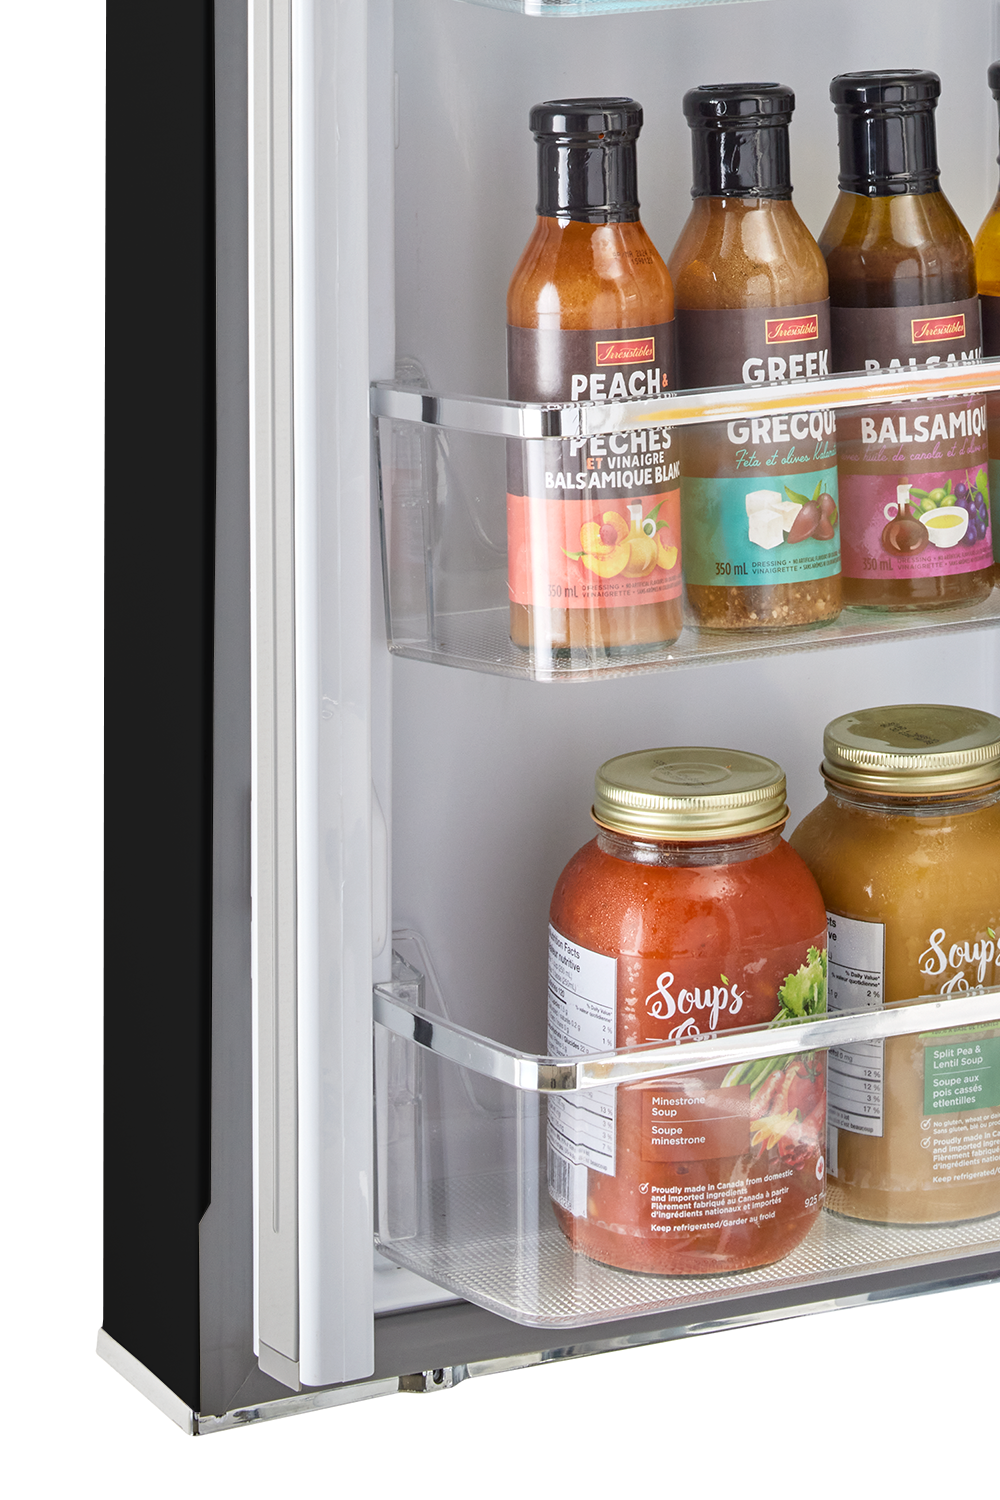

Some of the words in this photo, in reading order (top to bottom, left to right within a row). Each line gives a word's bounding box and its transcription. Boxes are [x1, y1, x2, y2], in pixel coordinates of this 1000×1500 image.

[742, 349, 828, 384] GREEK
[571, 368, 660, 401] PEACH
[662, 373, 668, 388] &
[586, 458, 603, 470] ET
[608, 452, 664, 469] VINAIGRE
[766, 450, 778, 466] et
[781, 446, 810, 464] olives
[545, 468, 652, 490] BALSAMIQUE
[716, 562, 731, 576] 350
[734, 562, 748, 576] mL
[752, 560, 787, 568] DRESSING
[752, 566, 798, 575] VINAIGRETTE
[933, 1050, 954, 1059] Split
[956, 1047, 973, 1056] Pea
[974, 1045, 982, 1054] &
[933, 1058, 959, 1069] Lentil
[961, 1056, 984, 1067] Soup
[932, 1076, 962, 1088] Soupe
[963, 1074, 980, 1083] aux
[932, 1088, 952, 1098] pois
[954, 1083, 982, 1095] cassés
[652, 1096, 706, 1106] Minestrone
[652, 1108, 678, 1118] Soup
[652, 1126, 683, 1136] Soupe
[652, 1136, 706, 1146] minestrone
[651, 1186, 683, 1194] Proudly
[684, 1184, 706, 1193] made
[716, 1180, 744, 1190] Canada
[746, 1176, 763, 1186] from
[764, 1170, 794, 1182] domestic
[651, 1194, 666, 1202] and
[668, 1193, 704, 1203] imported
[706, 1188, 748, 1200] ingredients
[651, 1202, 692, 1210] Fièrement
[693, 1198, 726, 1210] fabriqué
[738, 1192, 764, 1204] Canada
[765, 1190, 770, 1198] à
[771, 1186, 790, 1198] partir
[804, 1194, 818, 1208] 925
[651, 1210, 703, 1220] d'ingrédients
[704, 1205, 742, 1216] nationaux
[742, 1203, 750, 1211] et
[752, 1196, 782, 1210] importés
[651, 1224, 672, 1233] Keep
[673, 1217, 748, 1232] refrigerated/Garder
[759, 1211, 776, 1221] froid
